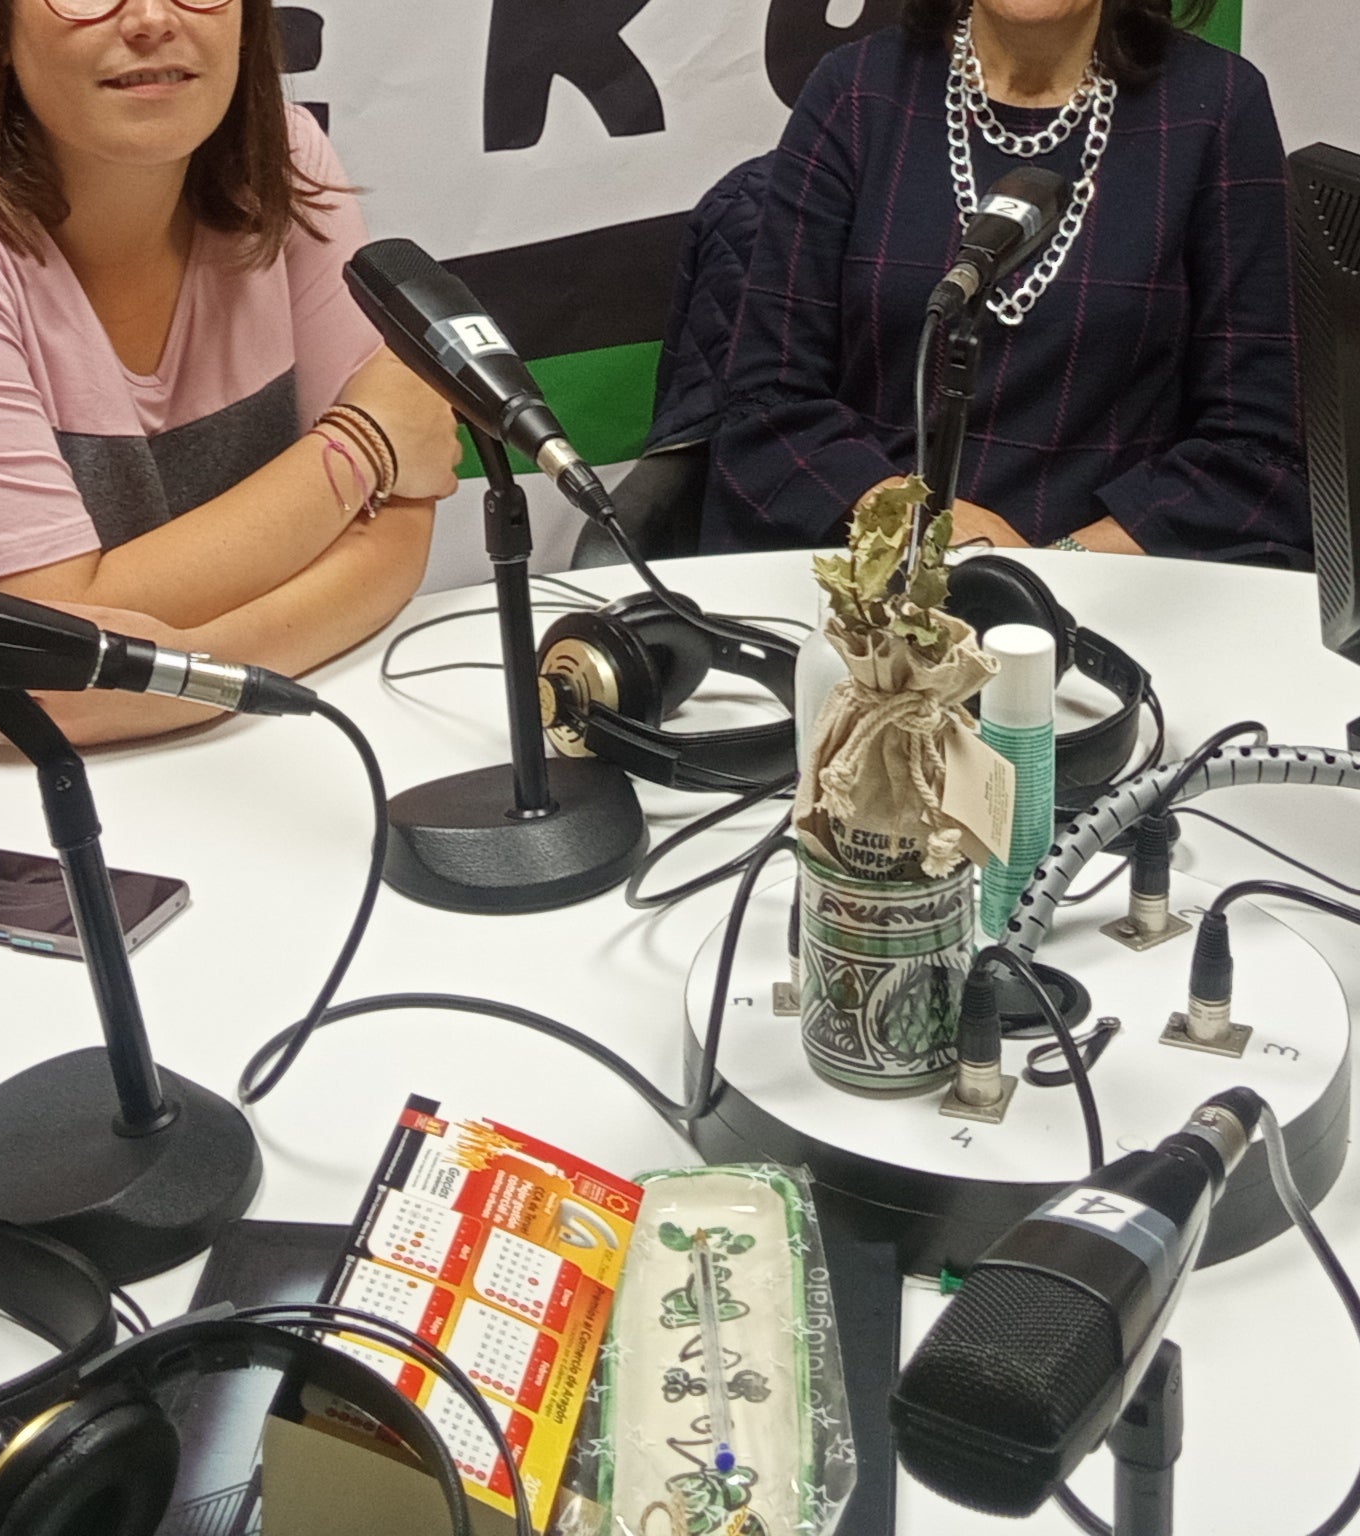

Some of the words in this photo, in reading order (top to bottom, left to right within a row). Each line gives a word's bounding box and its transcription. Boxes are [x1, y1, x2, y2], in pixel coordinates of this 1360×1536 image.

[996, 200, 1019, 215] 2
[465, 322, 498, 348] 1
[949, 1126, 973, 1149] 4
[437, 1166, 460, 1200] Gracias
[1073, 1195, 1125, 1215] 4
[569, 1329, 592, 1374] Comercio
[552, 1386, 574, 1424] Aragón
